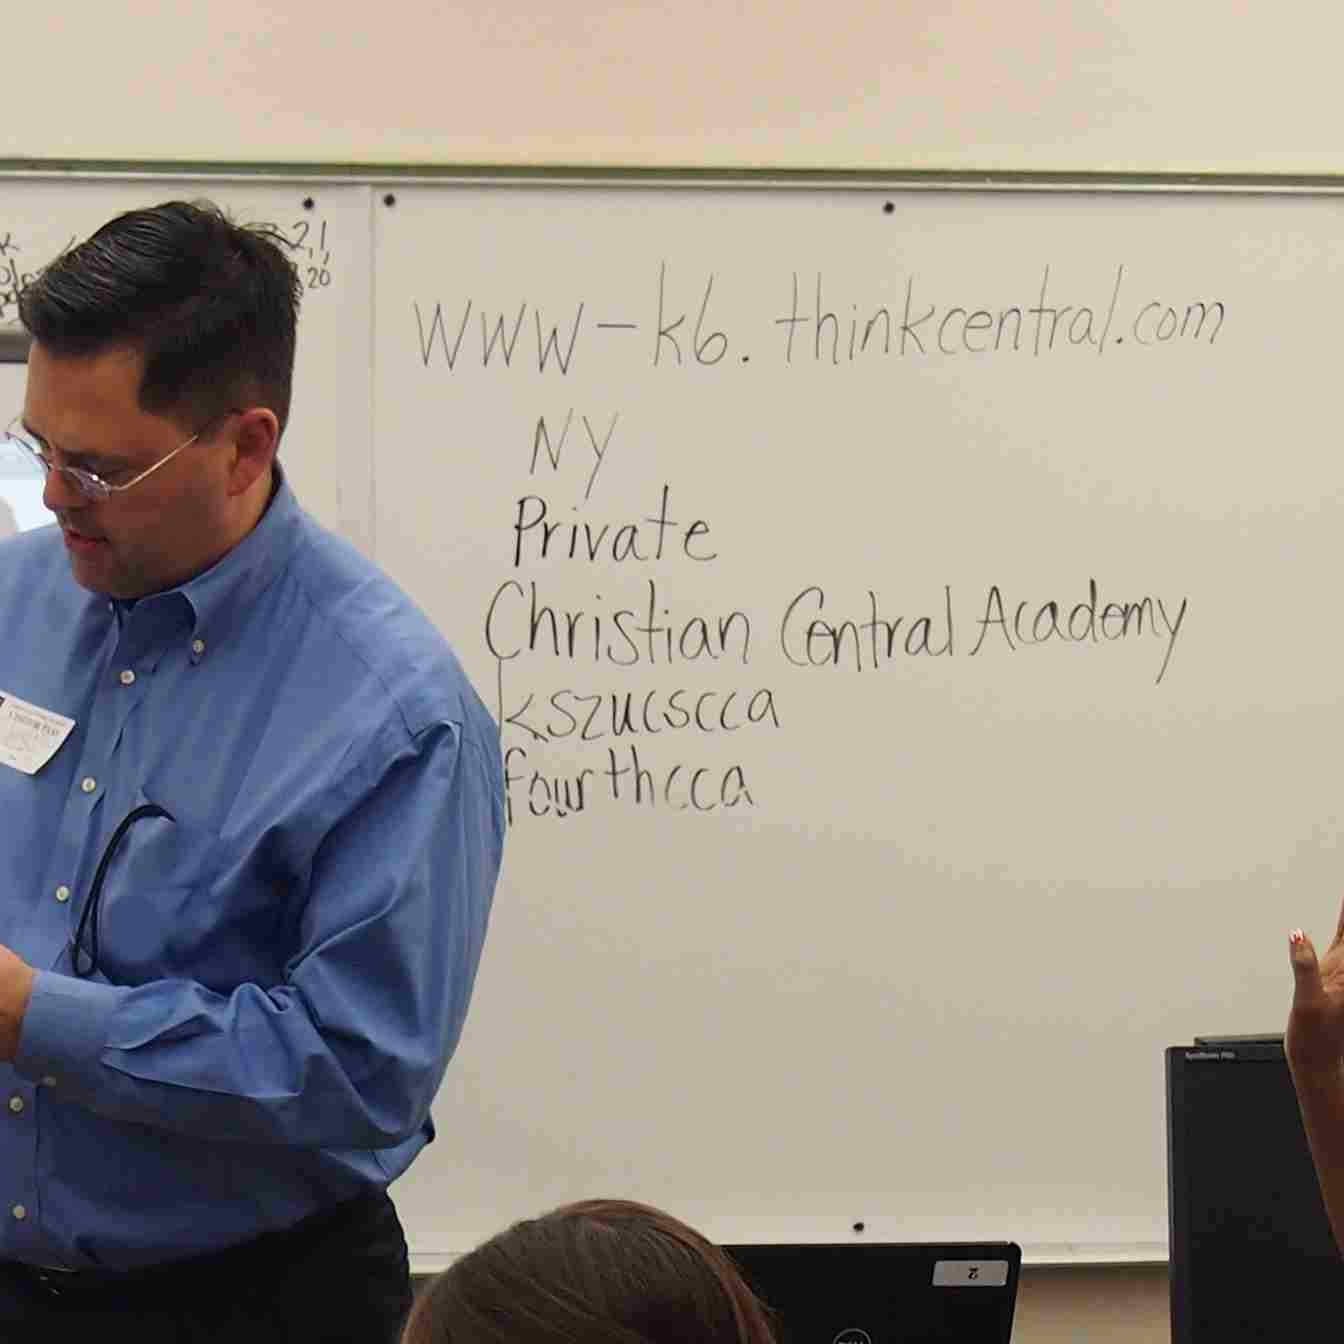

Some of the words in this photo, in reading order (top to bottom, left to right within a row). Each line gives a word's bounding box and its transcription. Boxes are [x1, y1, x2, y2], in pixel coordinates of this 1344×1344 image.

[513, 484, 718, 568] Private
[485, 579, 751, 666] Christian
[780, 586, 954, 672] Central
[967, 578, 1188, 685] Academy
[504, 743, 754, 827] fourthcca
